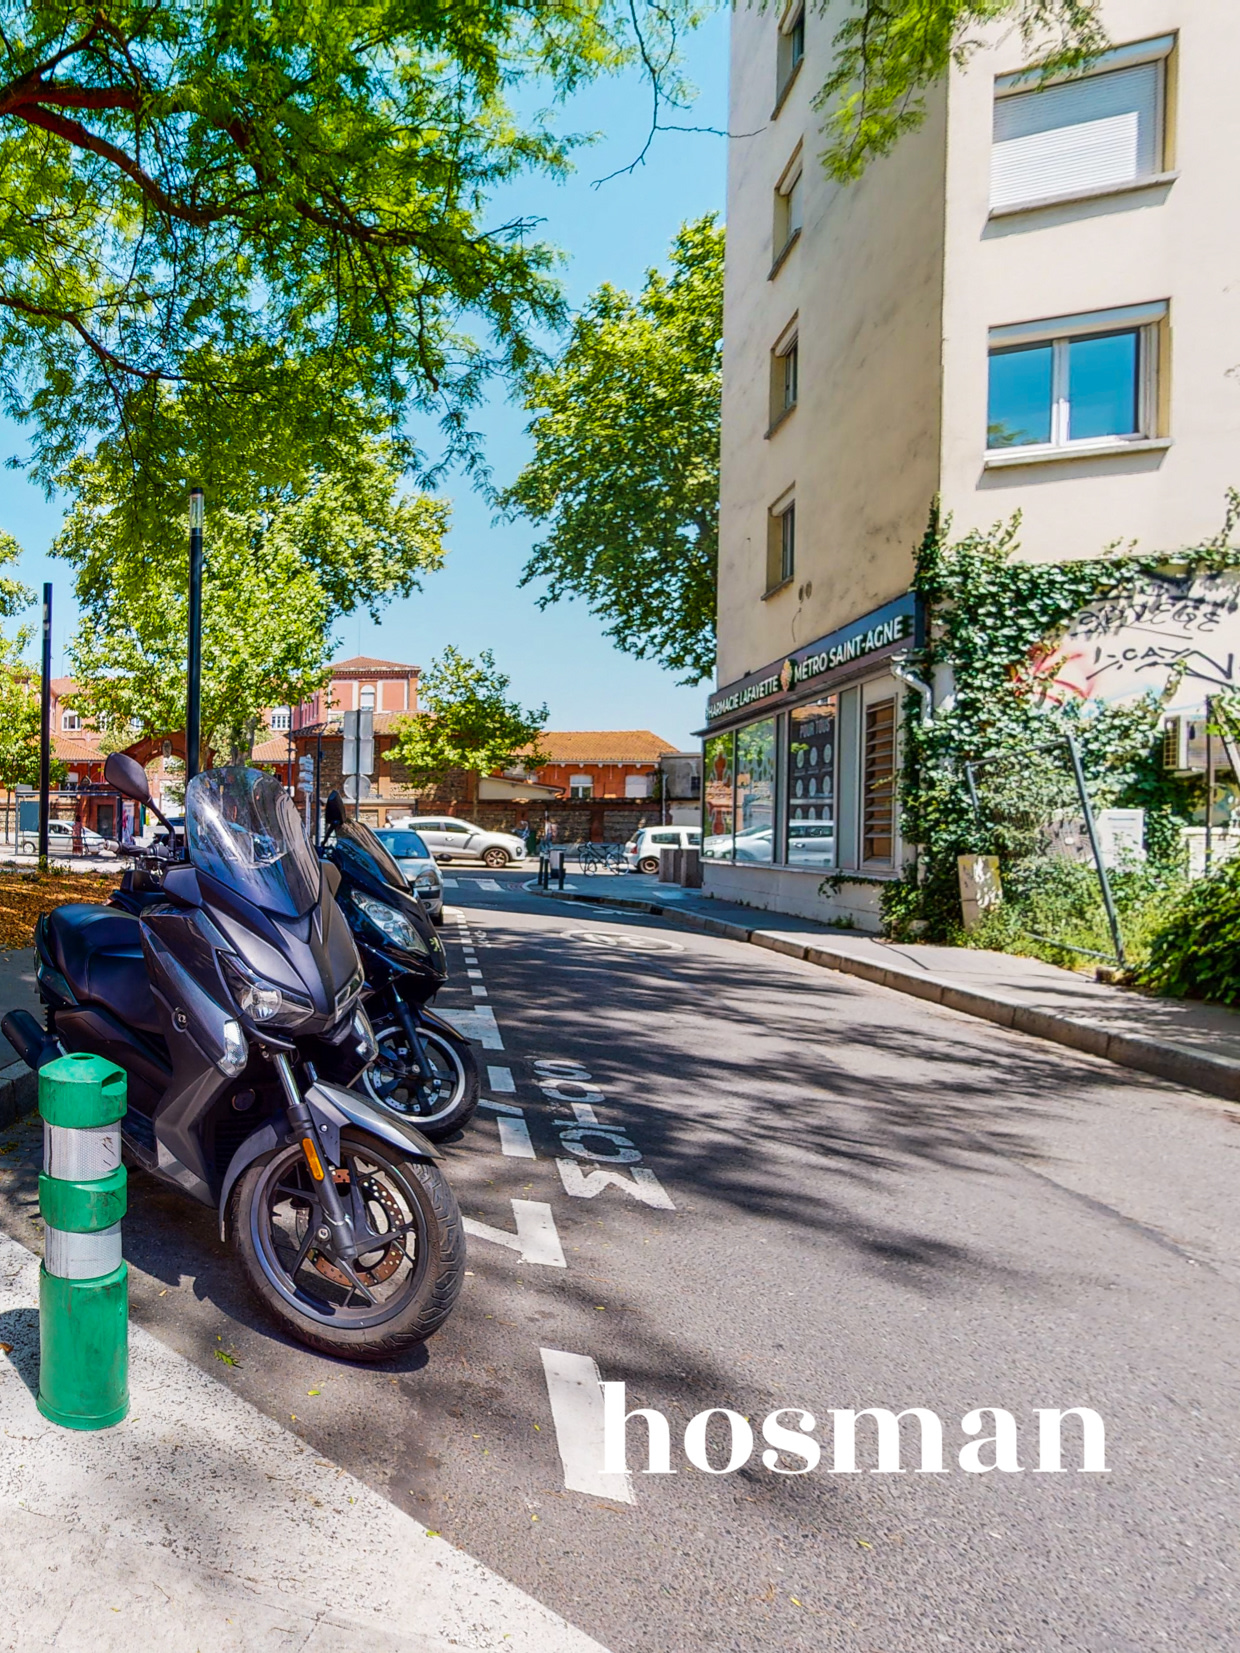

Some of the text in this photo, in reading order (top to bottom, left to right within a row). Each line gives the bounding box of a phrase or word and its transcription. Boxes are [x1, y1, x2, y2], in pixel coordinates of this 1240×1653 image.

[740, 675, 778, 706] LAFAYETTE
[794, 652, 827, 682] MÉTRO
[829, 616, 903, 668] SAINT-AGNE
[533, 1060, 677, 1210] MOTOS
